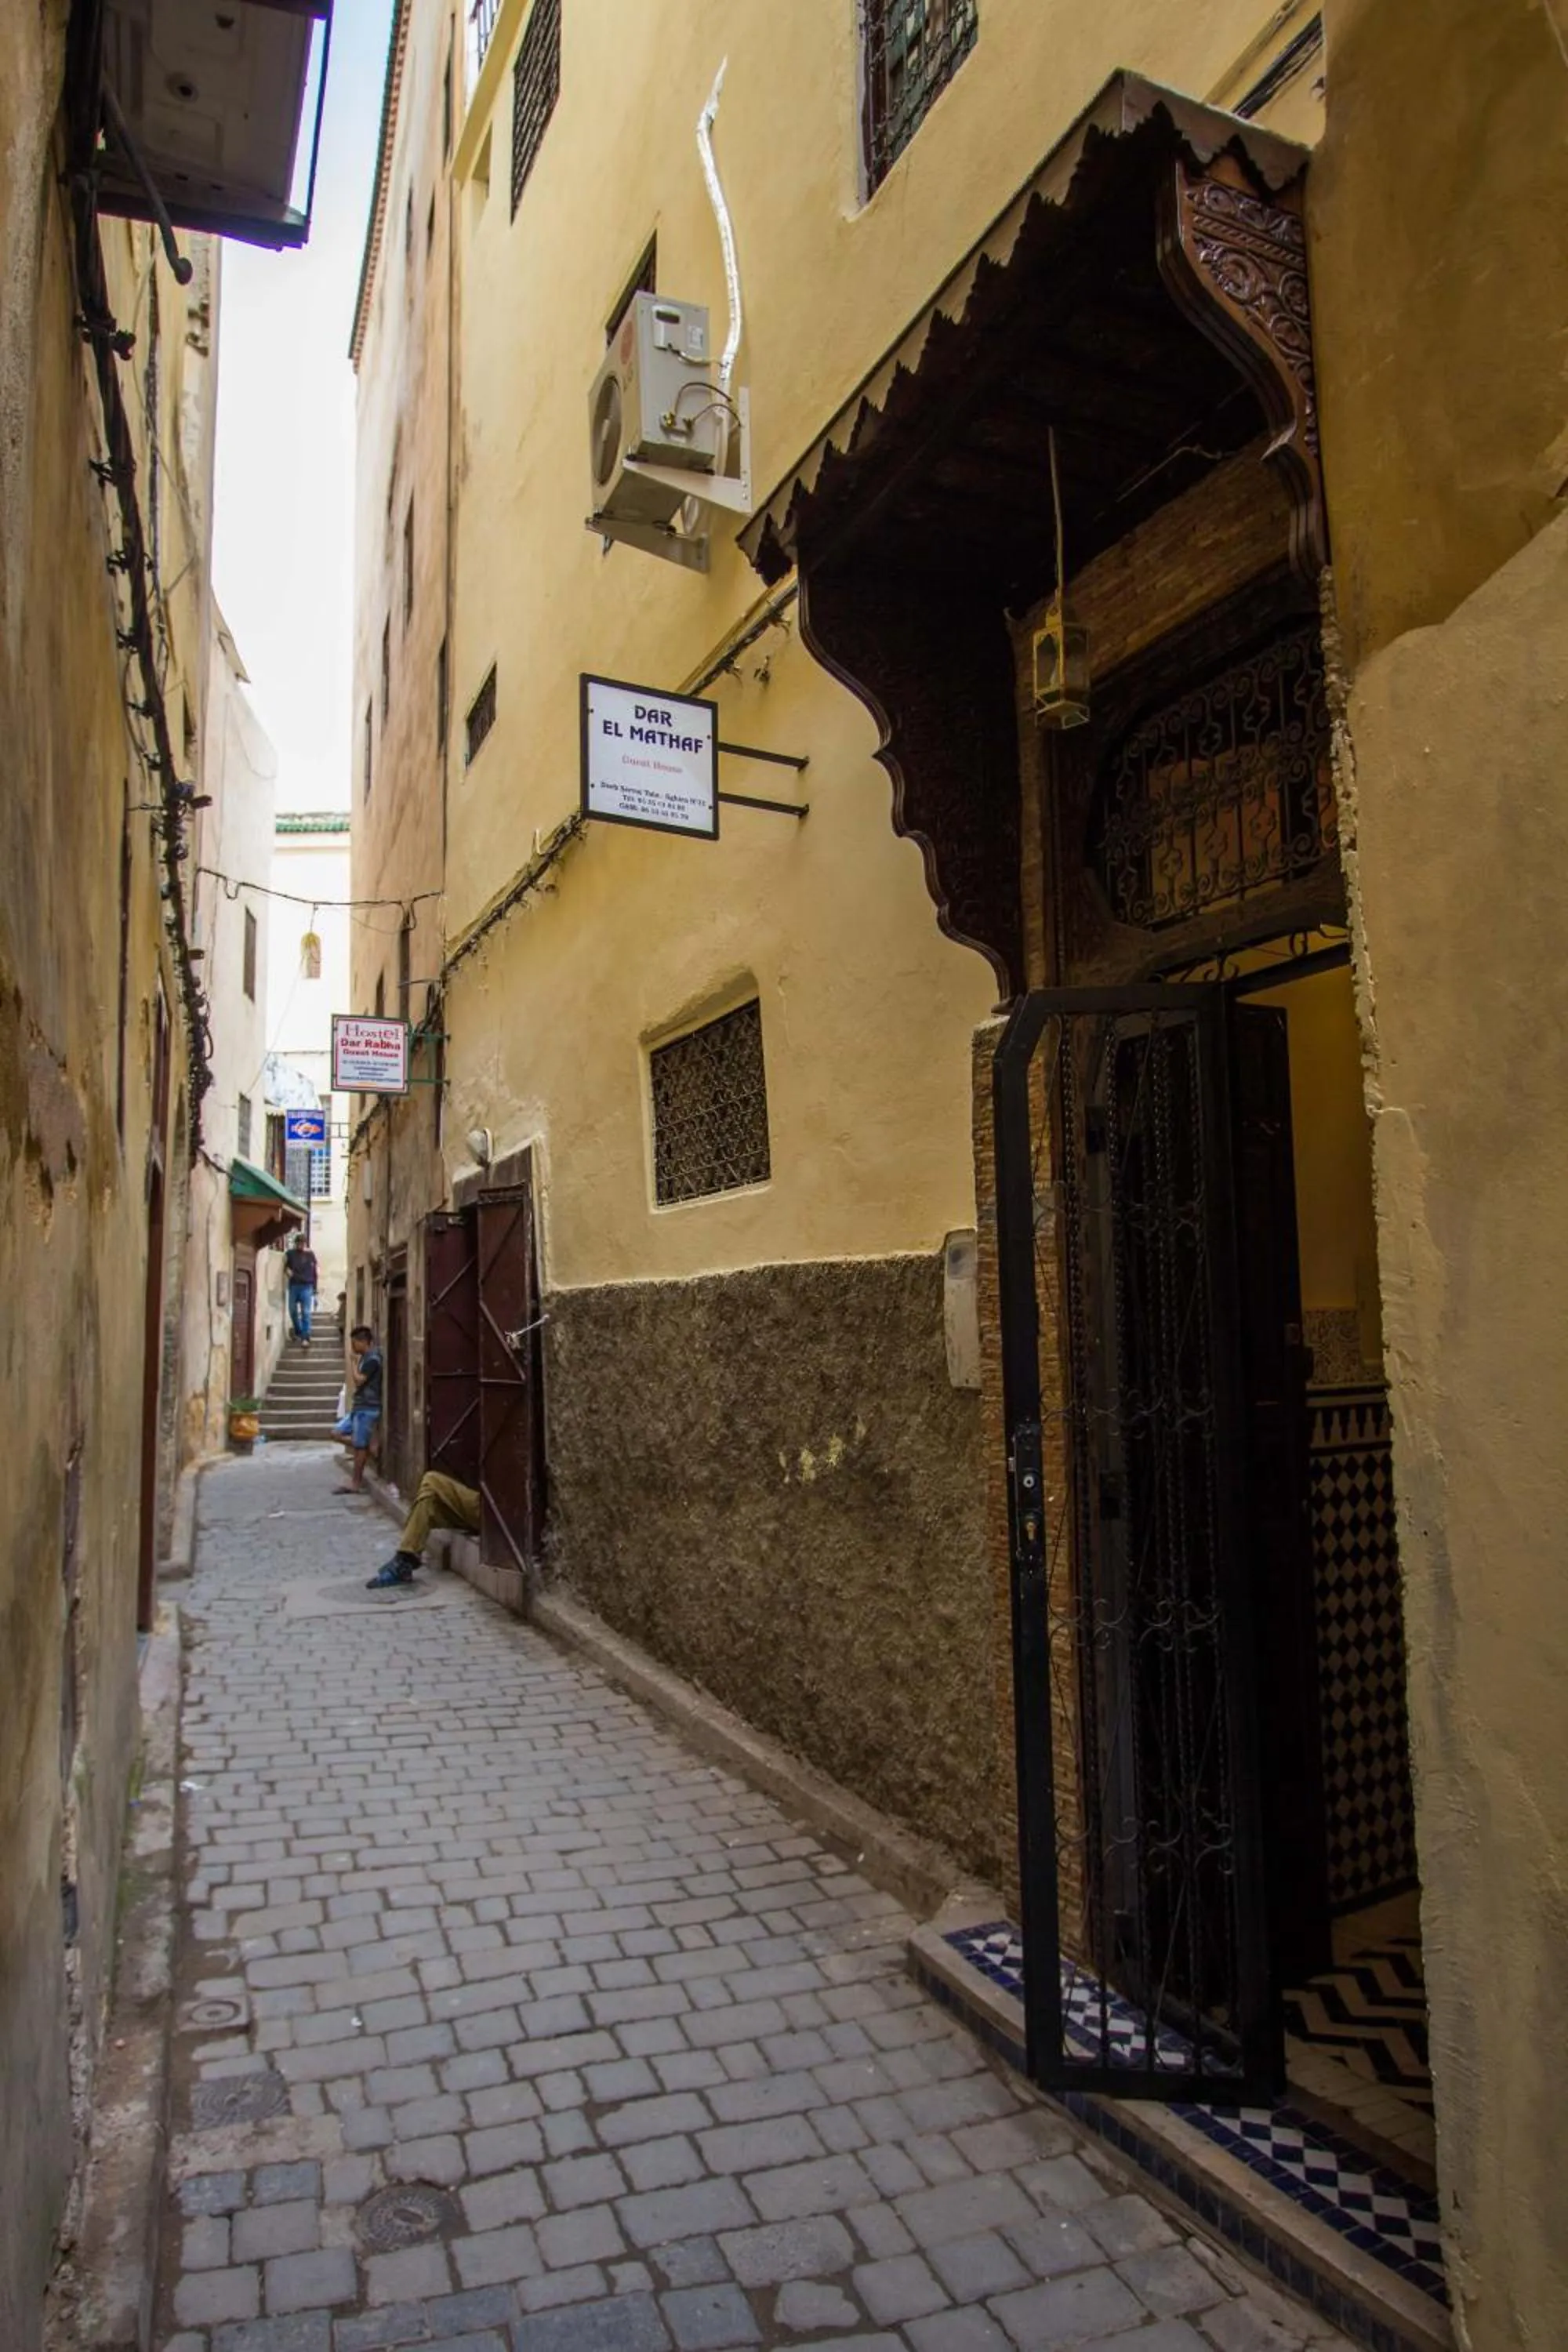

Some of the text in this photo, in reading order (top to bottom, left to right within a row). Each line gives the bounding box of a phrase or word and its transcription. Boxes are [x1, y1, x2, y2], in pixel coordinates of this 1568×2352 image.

[634, 705, 673, 727] DAR
[603, 719, 704, 753] EL MATHAF
[345, 1024, 400, 1040] Hostel
[340, 1037, 401, 1051] Dar Rabha
